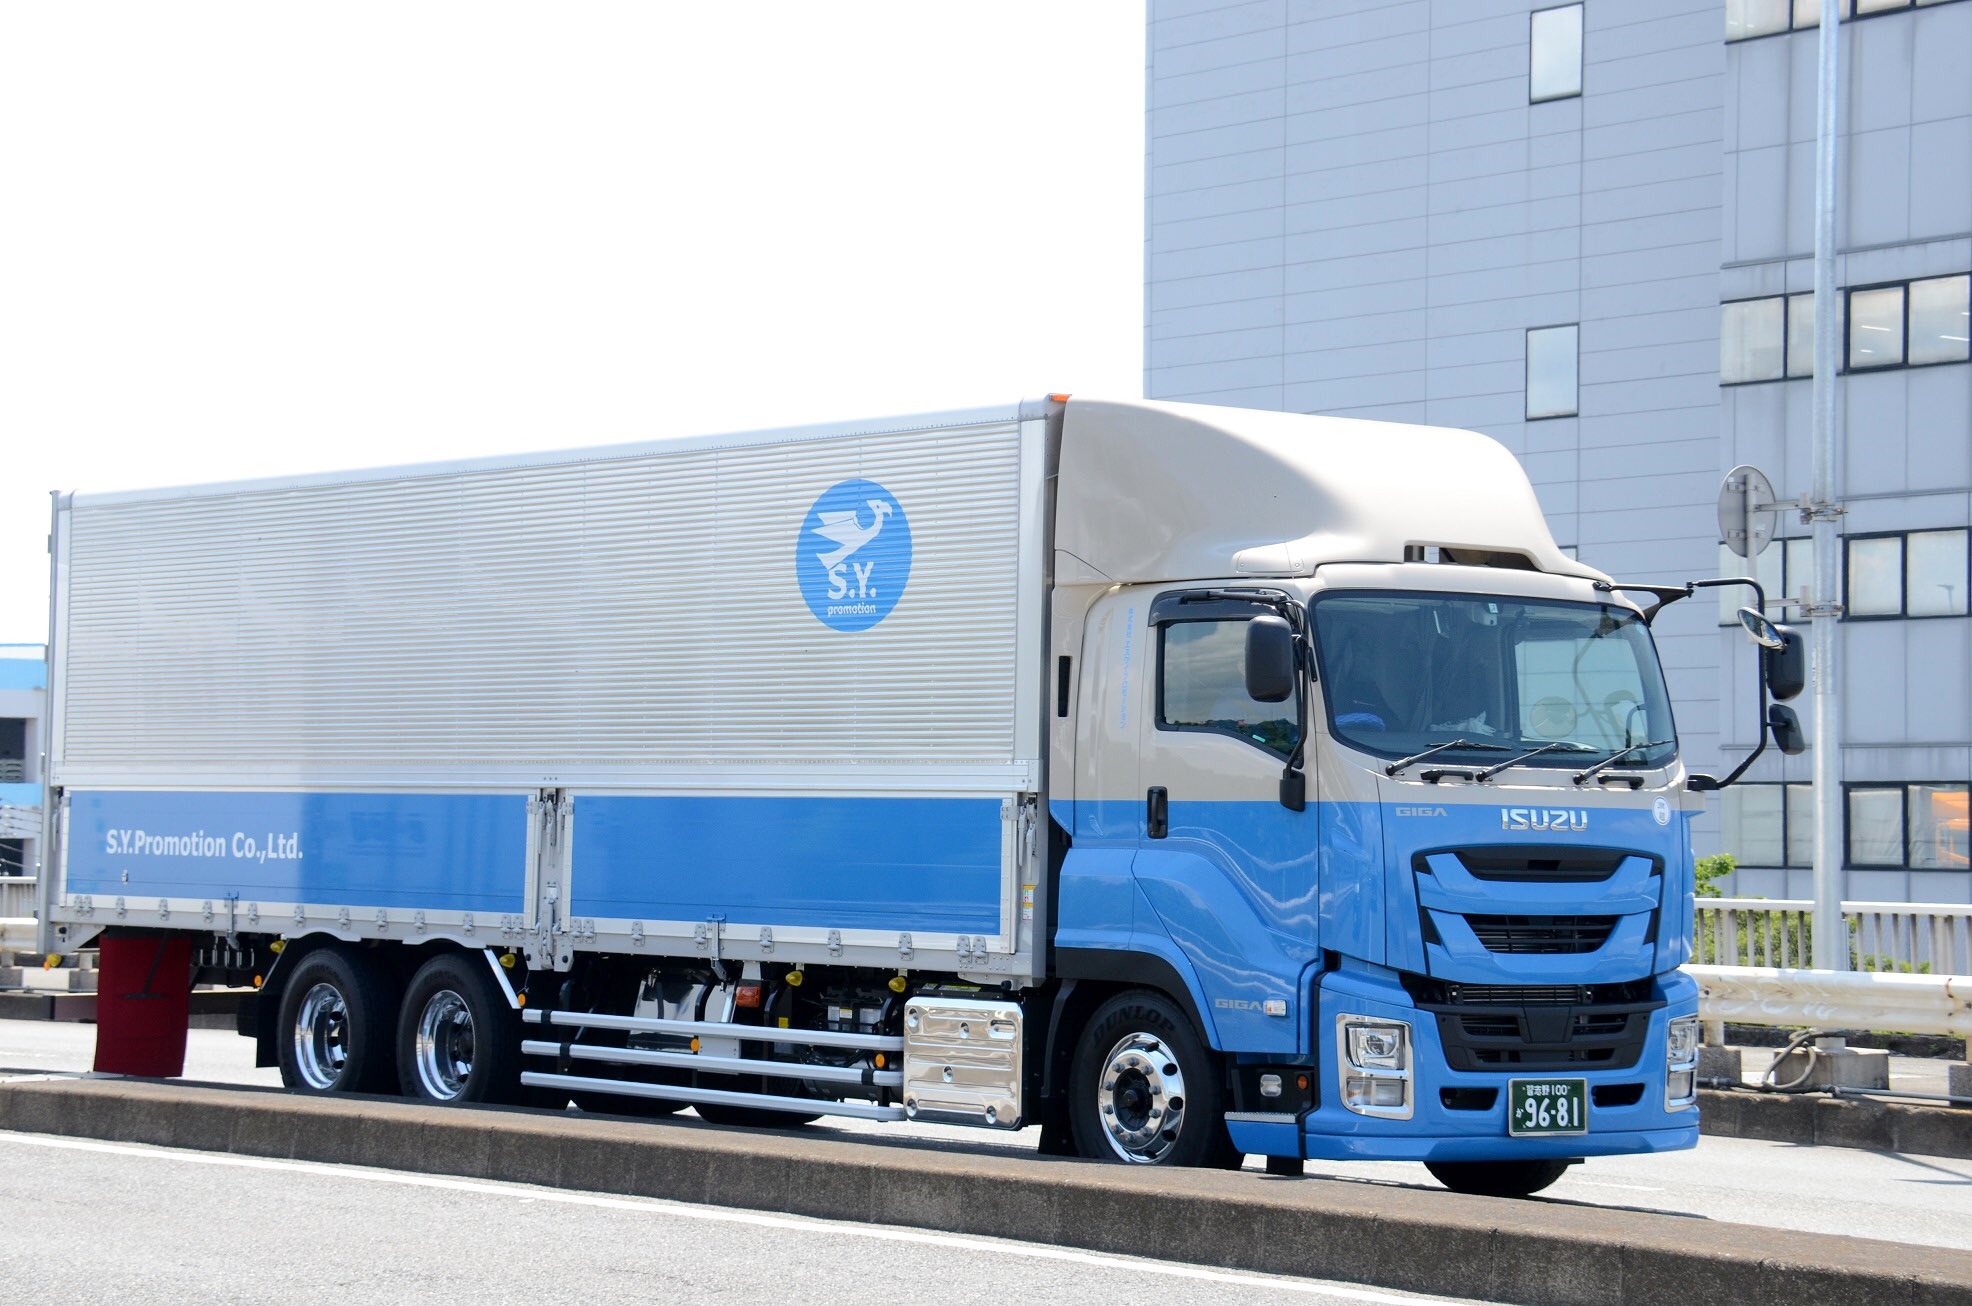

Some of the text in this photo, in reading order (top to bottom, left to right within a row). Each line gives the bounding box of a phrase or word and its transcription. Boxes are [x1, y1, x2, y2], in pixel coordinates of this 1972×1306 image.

[827, 561, 877, 600] S.Y.
[827, 602, 877, 617] promotion
[1395, 807, 1448, 817] GIGA
[1501, 808, 1588, 832] ISUZU
[106, 829, 304, 864] S.Y.Promotion Co.,Ltd.
[1215, 998, 1263, 1011] GIGA
[1094, 1005, 1176, 1041] DUNLOP
[1551, 1084, 1568, 1096] 100
[1525, 1097, 1579, 1128] 96-81
